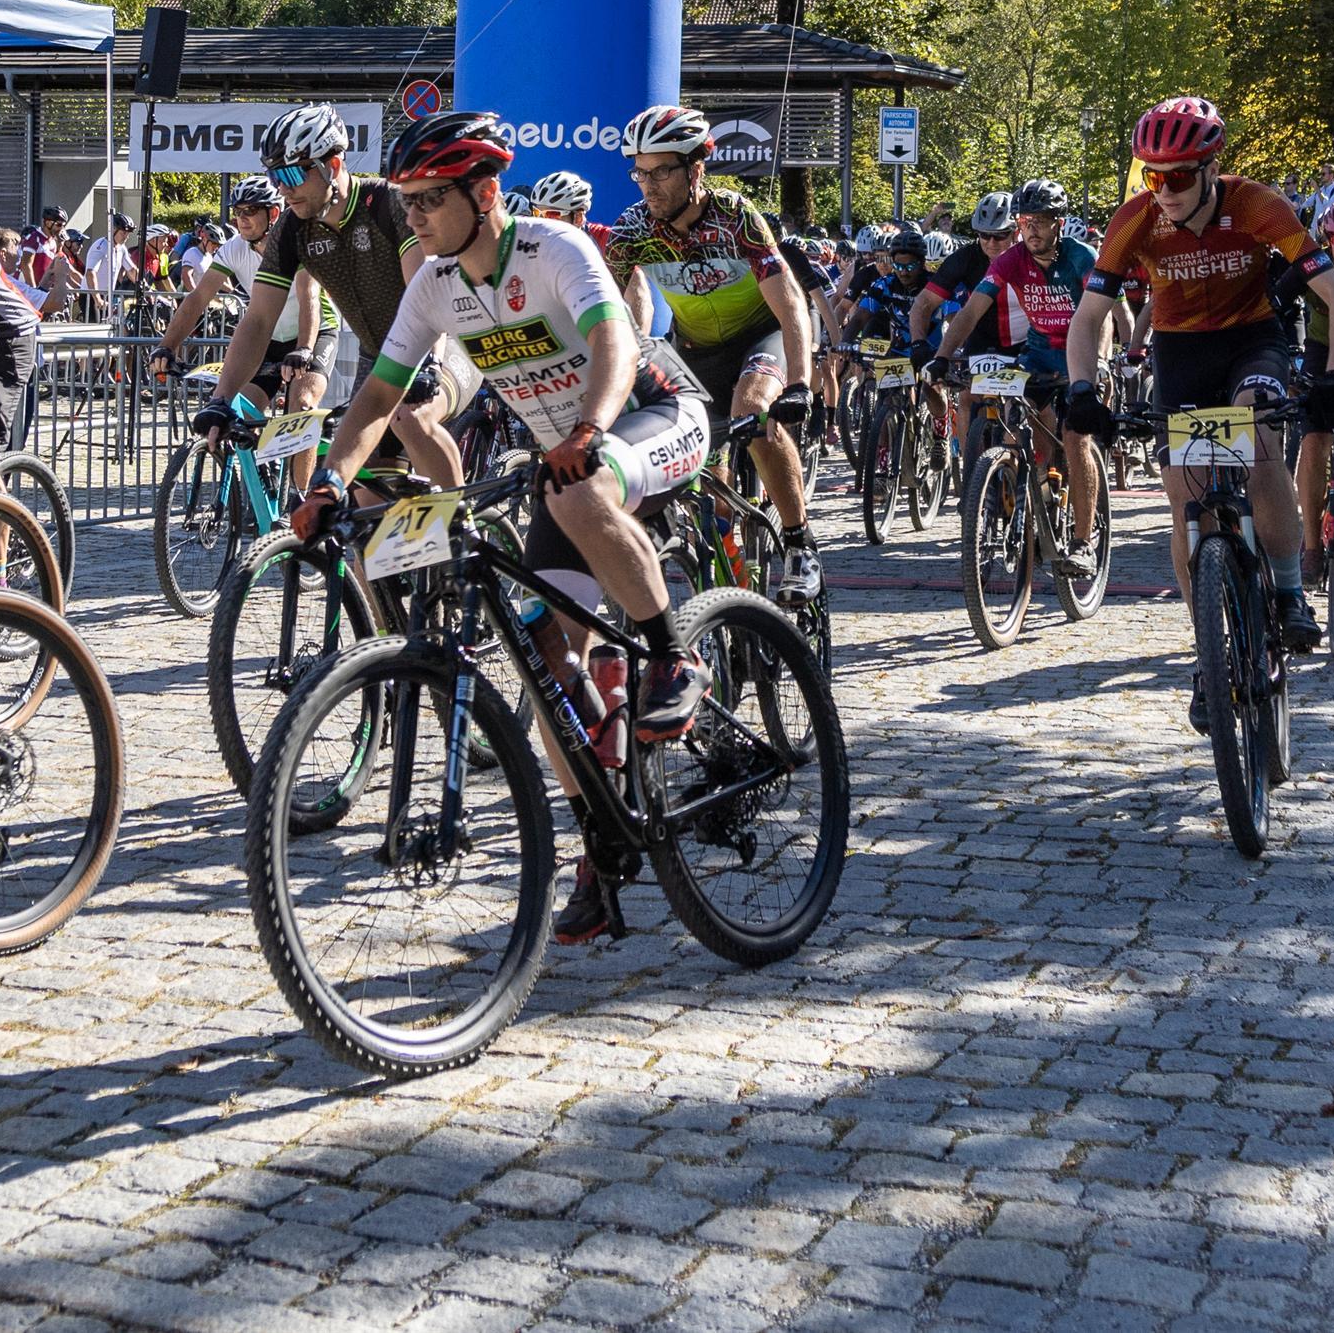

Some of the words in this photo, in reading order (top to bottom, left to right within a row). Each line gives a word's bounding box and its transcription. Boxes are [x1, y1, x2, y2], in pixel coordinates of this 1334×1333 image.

[142, 124, 244, 152] DMG
[500, 117, 621, 150] aeu.de
[704, 145, 773, 162] kinfit
[307, 239, 332, 257] FBT
[1167, 250, 1244, 268] RADMARATHON
[1156, 254, 1254, 281] FINISHER
[1023, 283, 1071, 295] SÜDTIROL
[480, 329, 527, 350] BURG
[868, 343, 885, 353] 356
[473, 341, 553, 369] WÄCHTER
[886, 364, 905, 376] 292
[987, 372, 1016, 381] 243
[501, 372, 582, 402] TEAM
[275, 415, 314, 438] 237
[1189, 419, 1231, 440] 221
[648, 426, 705, 467] CSV-MTB
[663, 449, 702, 484] TEAM
[386, 506, 435, 540] 217
